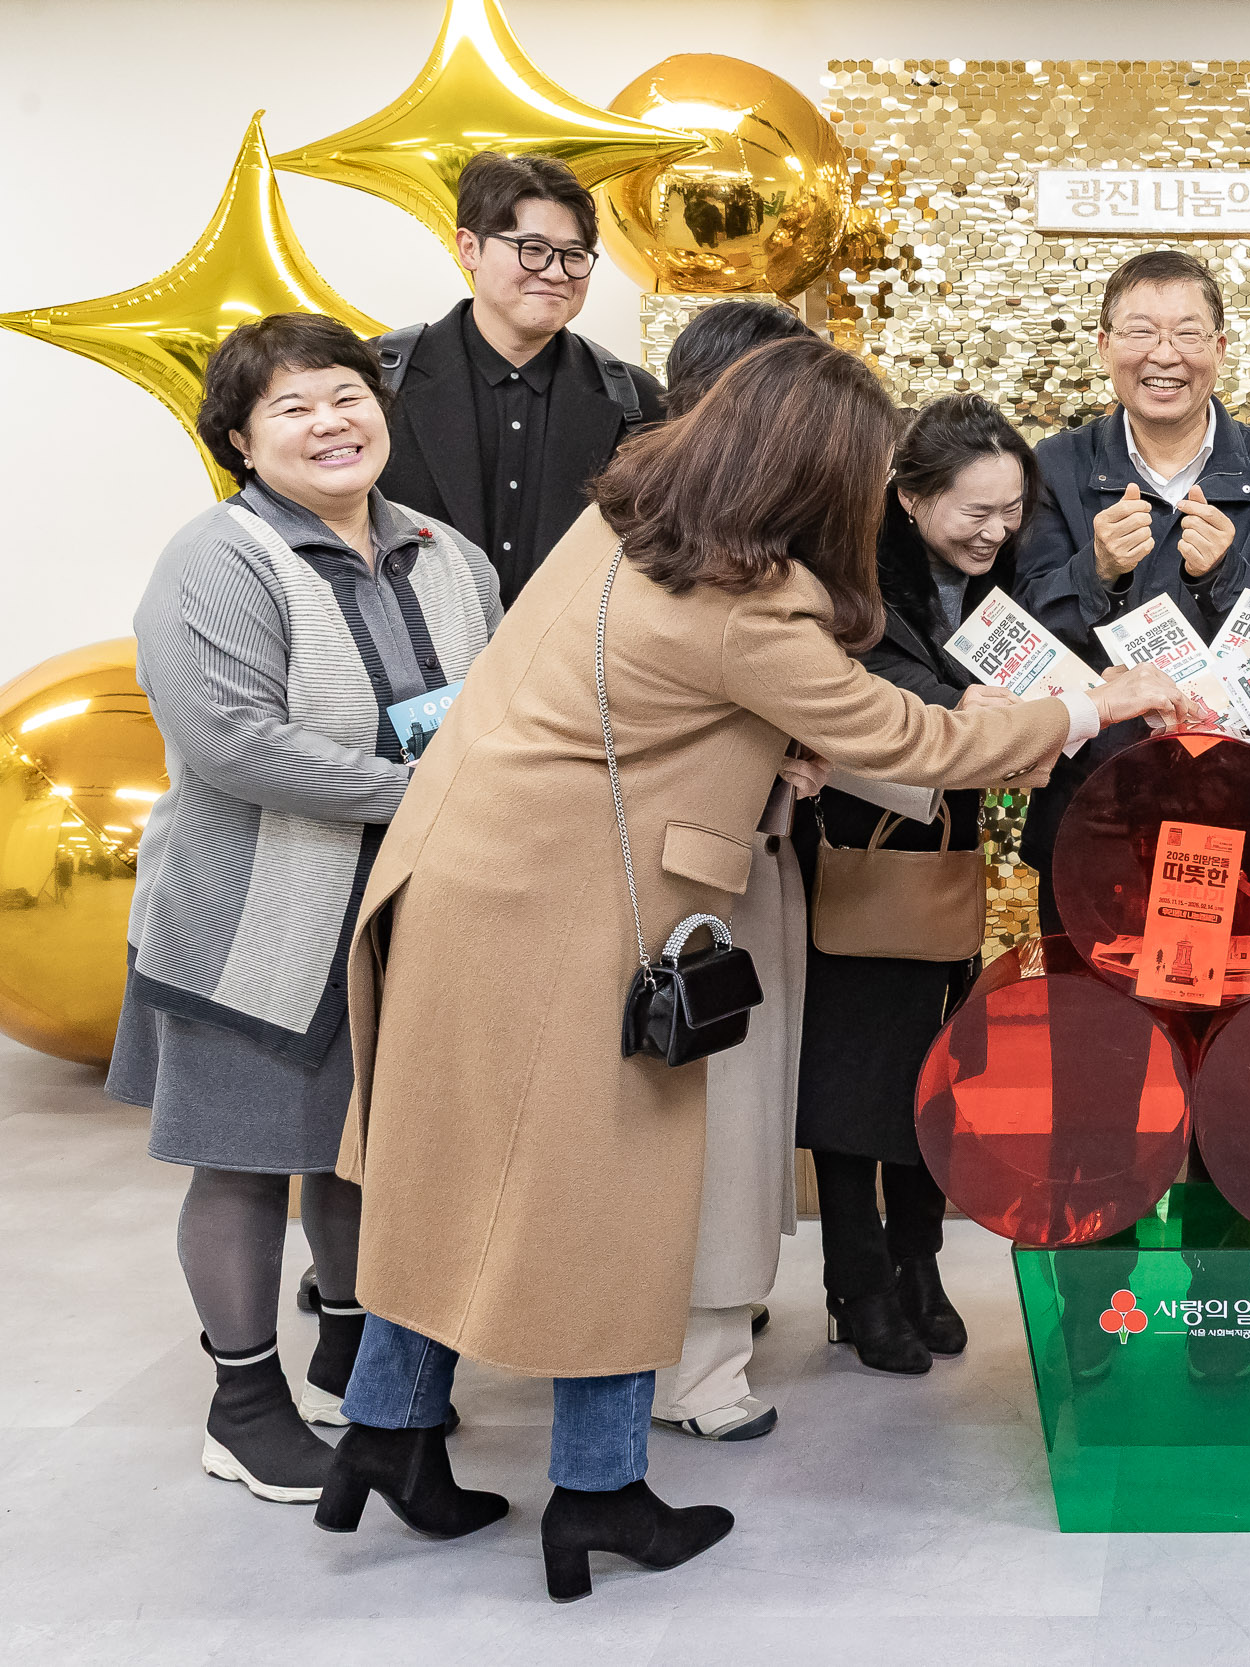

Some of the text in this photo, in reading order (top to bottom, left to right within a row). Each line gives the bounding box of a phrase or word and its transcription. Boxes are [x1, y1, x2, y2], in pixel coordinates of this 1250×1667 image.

[1065, 178, 1139, 217] 광진
[971, 642, 991, 663] 2026
[988, 612, 1017, 644] 희망온돌
[979, 620, 1031, 676] 따뜻한
[1125, 635, 1146, 651] 2026
[1130, 626, 1188, 664] 따뜻한
[994, 633, 1042, 685] 겨울나기
[1151, 641, 1196, 669] 울나기
[1166, 851, 1230, 869] 2026 희망온돌
[1162, 861, 1229, 888] 따뜻한
[1154, 1300, 1228, 1326] 사랑의
[1189, 1329, 1206, 1337] 서울
